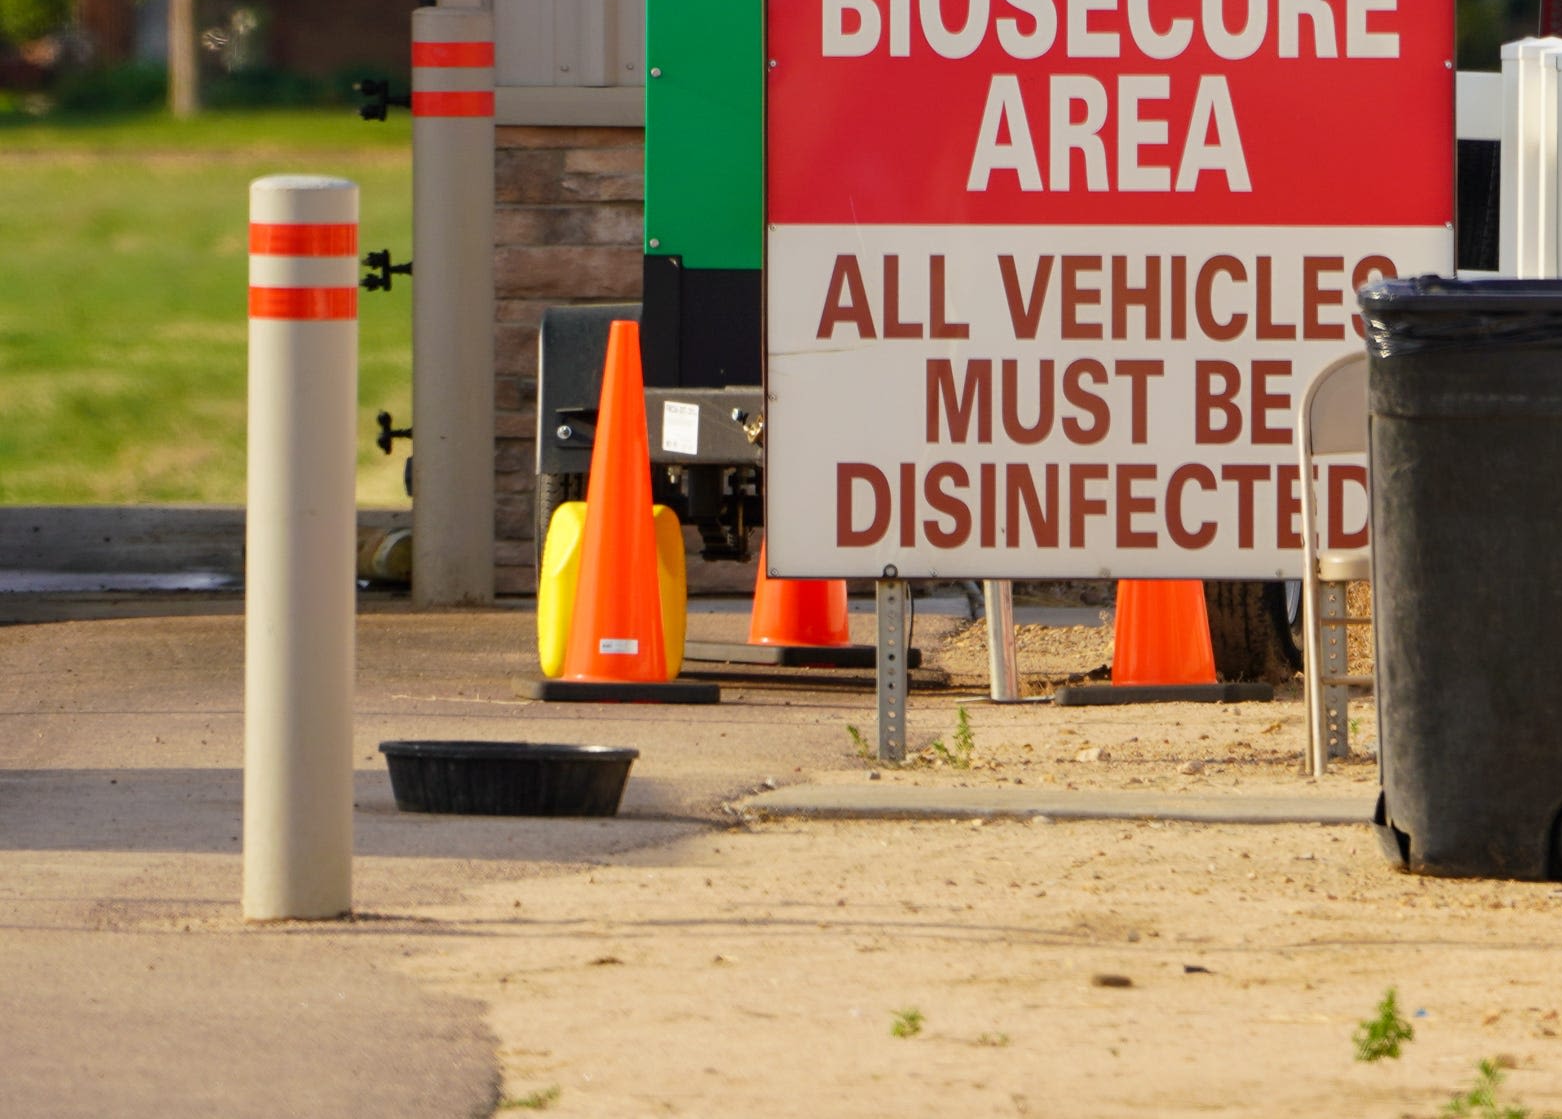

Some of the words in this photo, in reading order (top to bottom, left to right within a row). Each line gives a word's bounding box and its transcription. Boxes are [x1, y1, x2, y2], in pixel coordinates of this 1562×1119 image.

[965, 74, 1254, 193] AREA
[816, 255, 970, 340] ALL
[925, 359, 1165, 445] MUST
[1195, 359, 1294, 445] BE
[836, 461, 1370, 550] DISINFECTED
